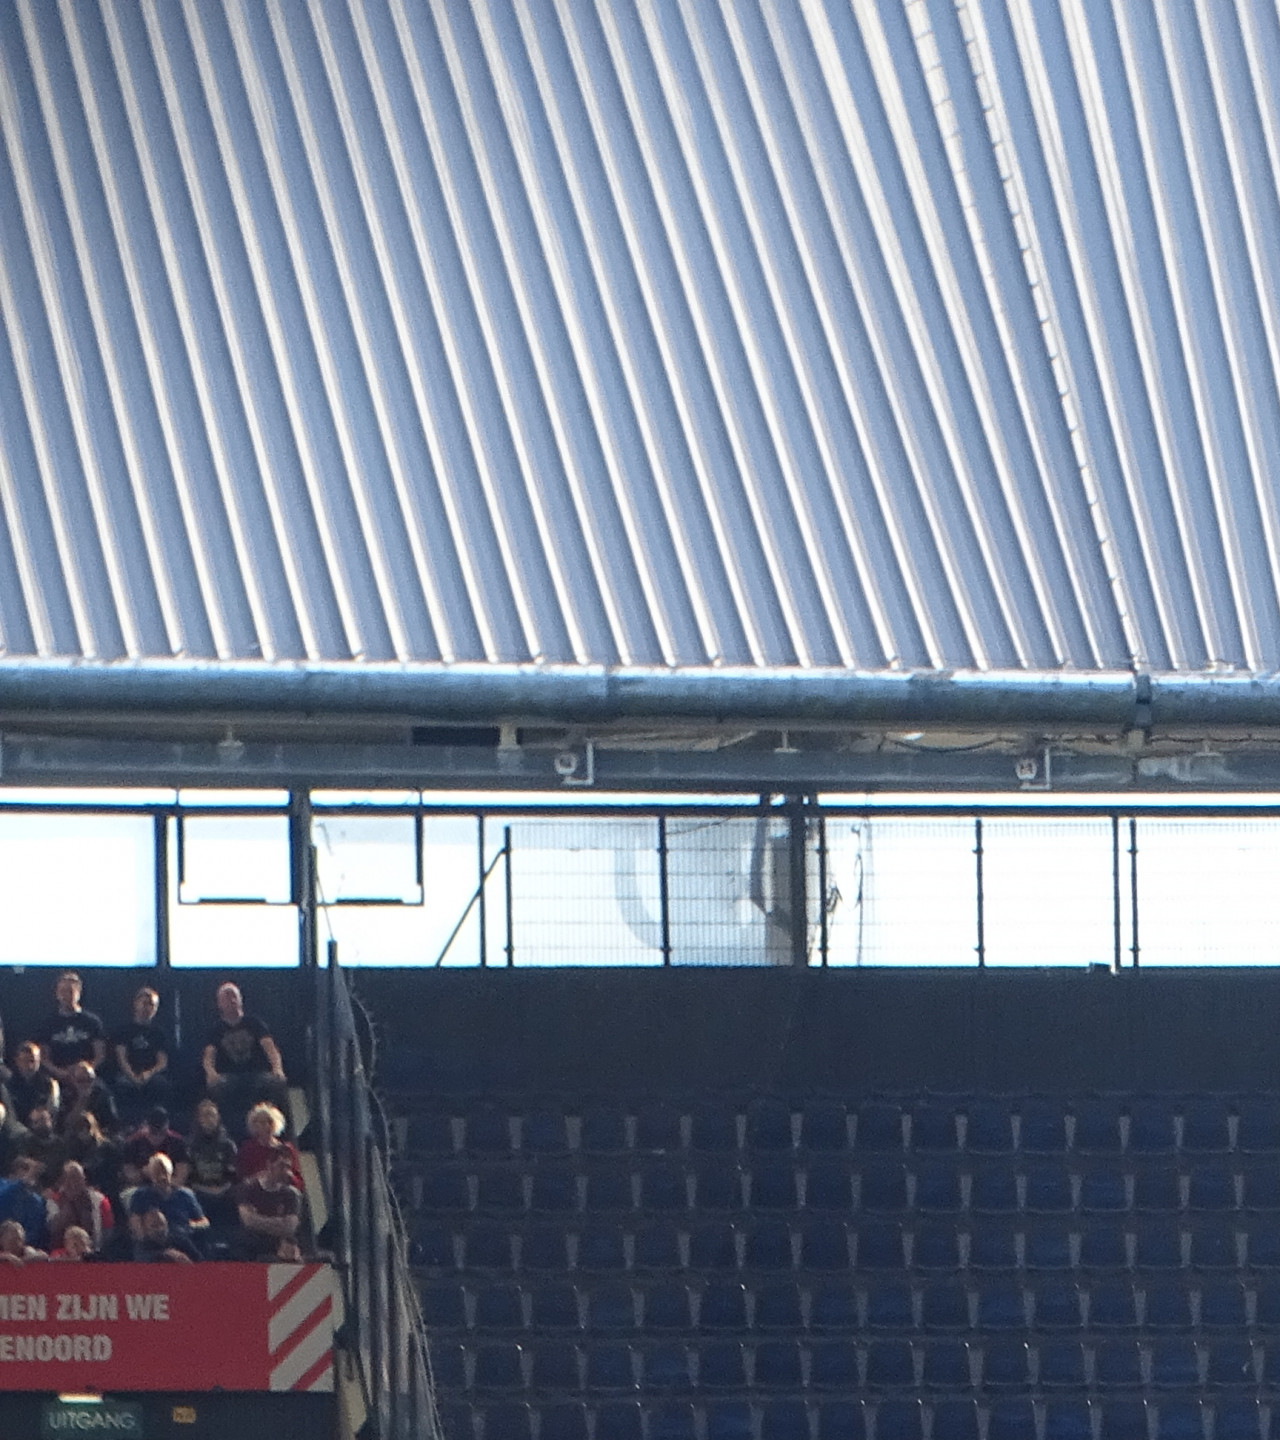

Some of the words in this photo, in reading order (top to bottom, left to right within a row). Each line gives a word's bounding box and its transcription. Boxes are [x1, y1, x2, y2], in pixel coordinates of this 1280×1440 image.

[56, 1293, 118, 1321] ZIJN
[125, 1294, 170, 1321] WE
[49, 1411, 137, 1430] UITGANG
